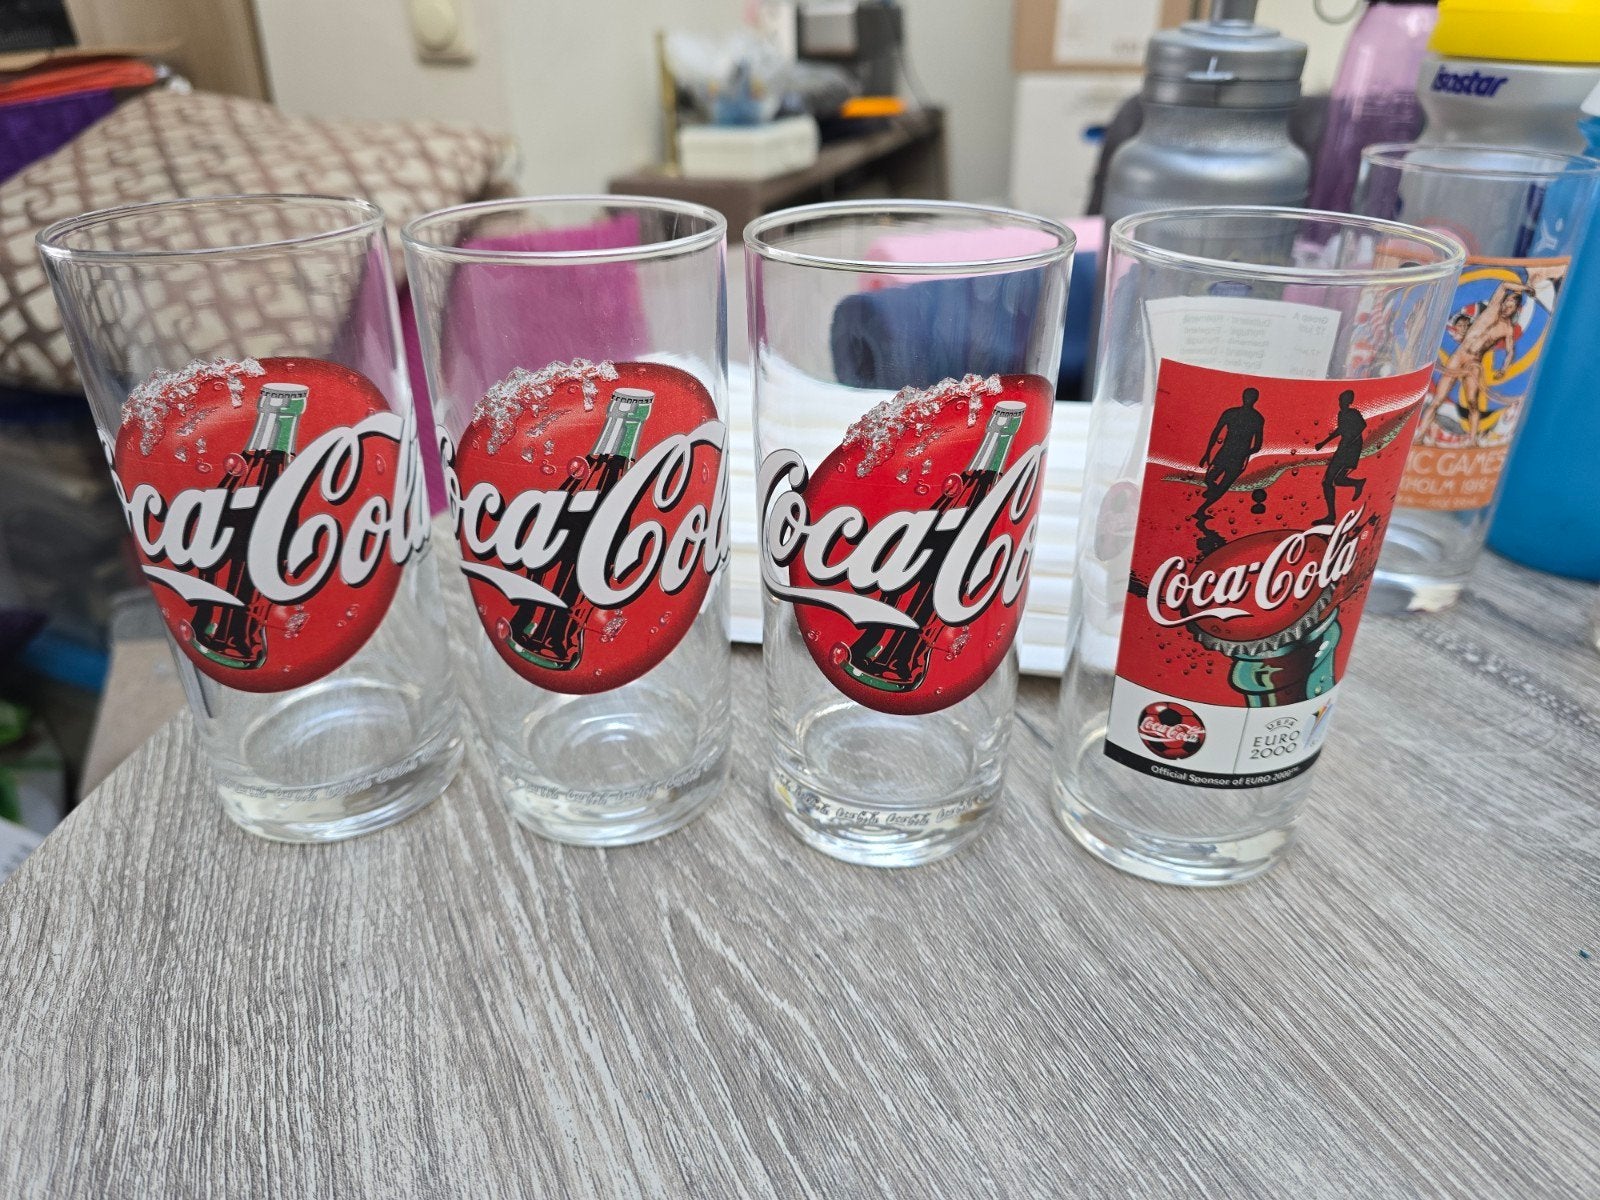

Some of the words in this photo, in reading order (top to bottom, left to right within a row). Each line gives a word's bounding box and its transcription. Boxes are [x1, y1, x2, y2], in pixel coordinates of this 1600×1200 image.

[1431, 64, 1509, 98] isostar
[1147, 502, 1366, 626] Coca-Cola
[1266, 718, 1295, 731] UEFA
[1253, 730, 1300, 747] EURO
[1249, 742, 1297, 760] 2000
[1150, 765, 1187, 781] Official
[1188, 774, 1229, 786] Sponsor
[1232, 778, 1244, 786] of
[1245, 775, 1271, 785] EURO
